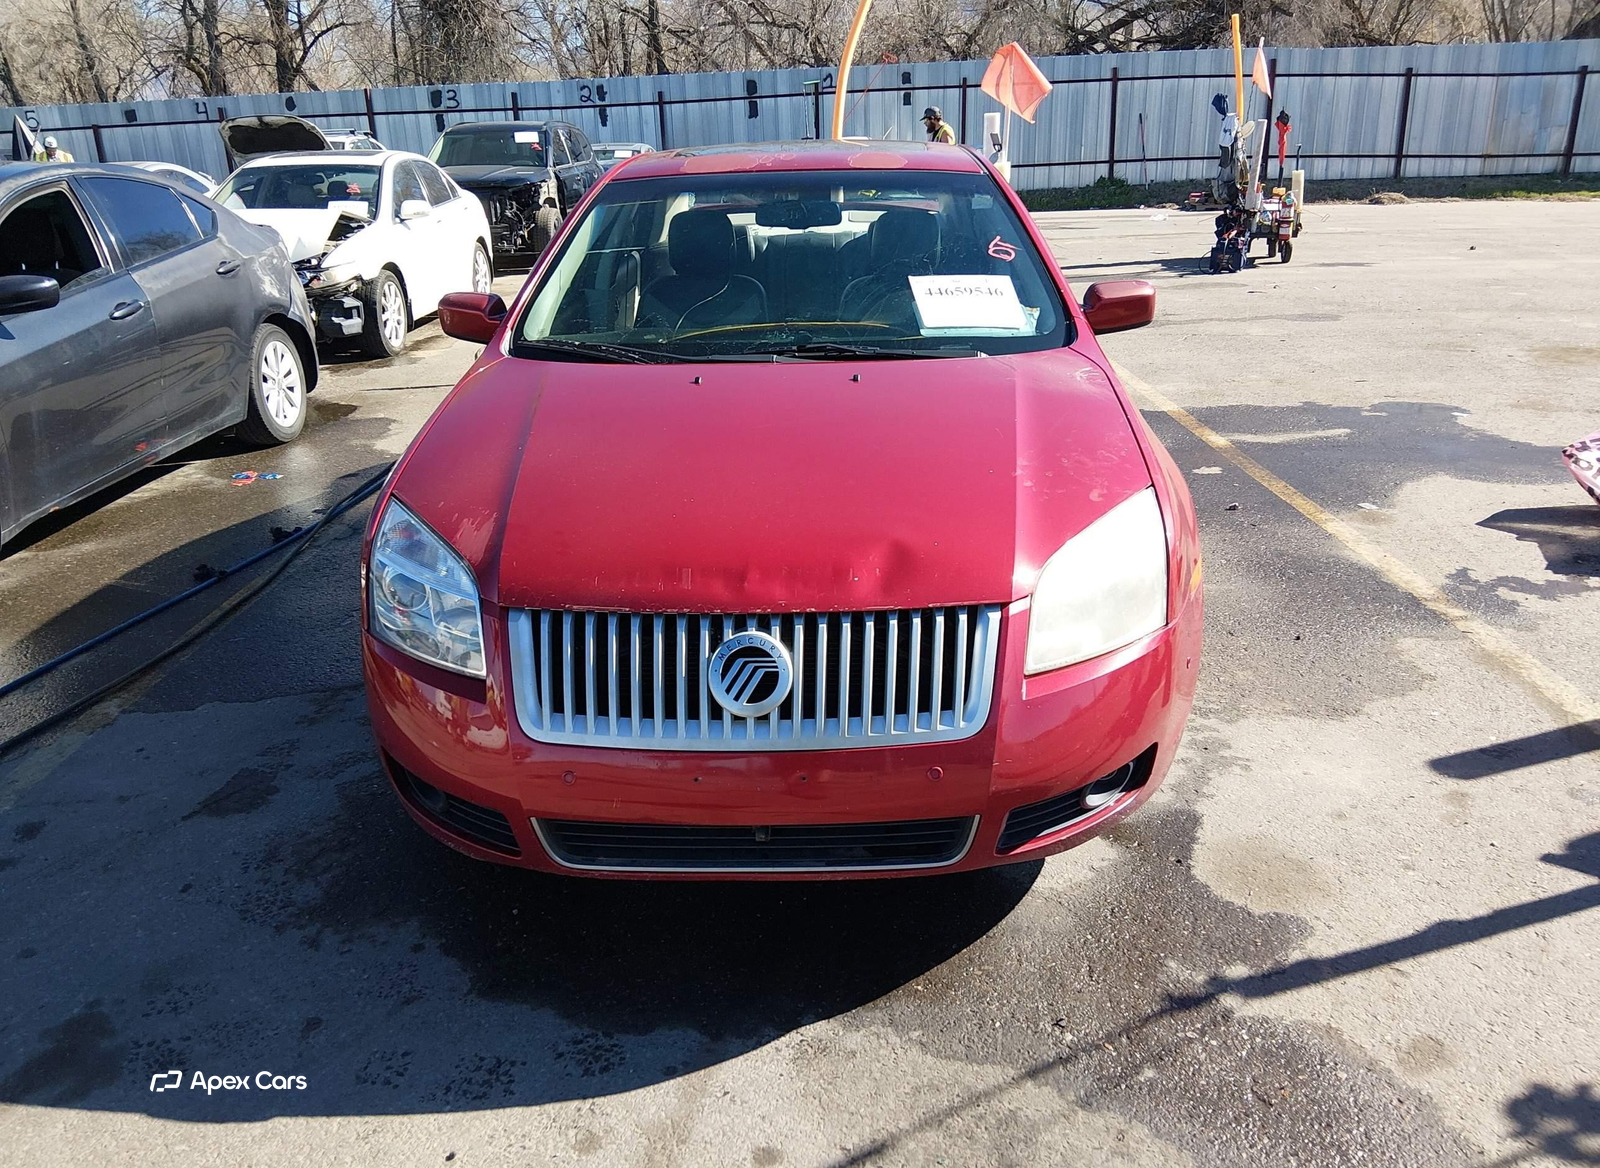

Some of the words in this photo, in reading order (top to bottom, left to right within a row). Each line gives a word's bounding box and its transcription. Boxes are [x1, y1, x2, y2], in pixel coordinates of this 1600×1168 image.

[446, 89, 460, 109] 3
[579, 85, 595, 103] 2
[25, 110, 39, 129] 5
[195, 102, 209, 120] 4
[924, 286, 1004, 297] 44659546
[718, 637, 784, 661] MERCURY
